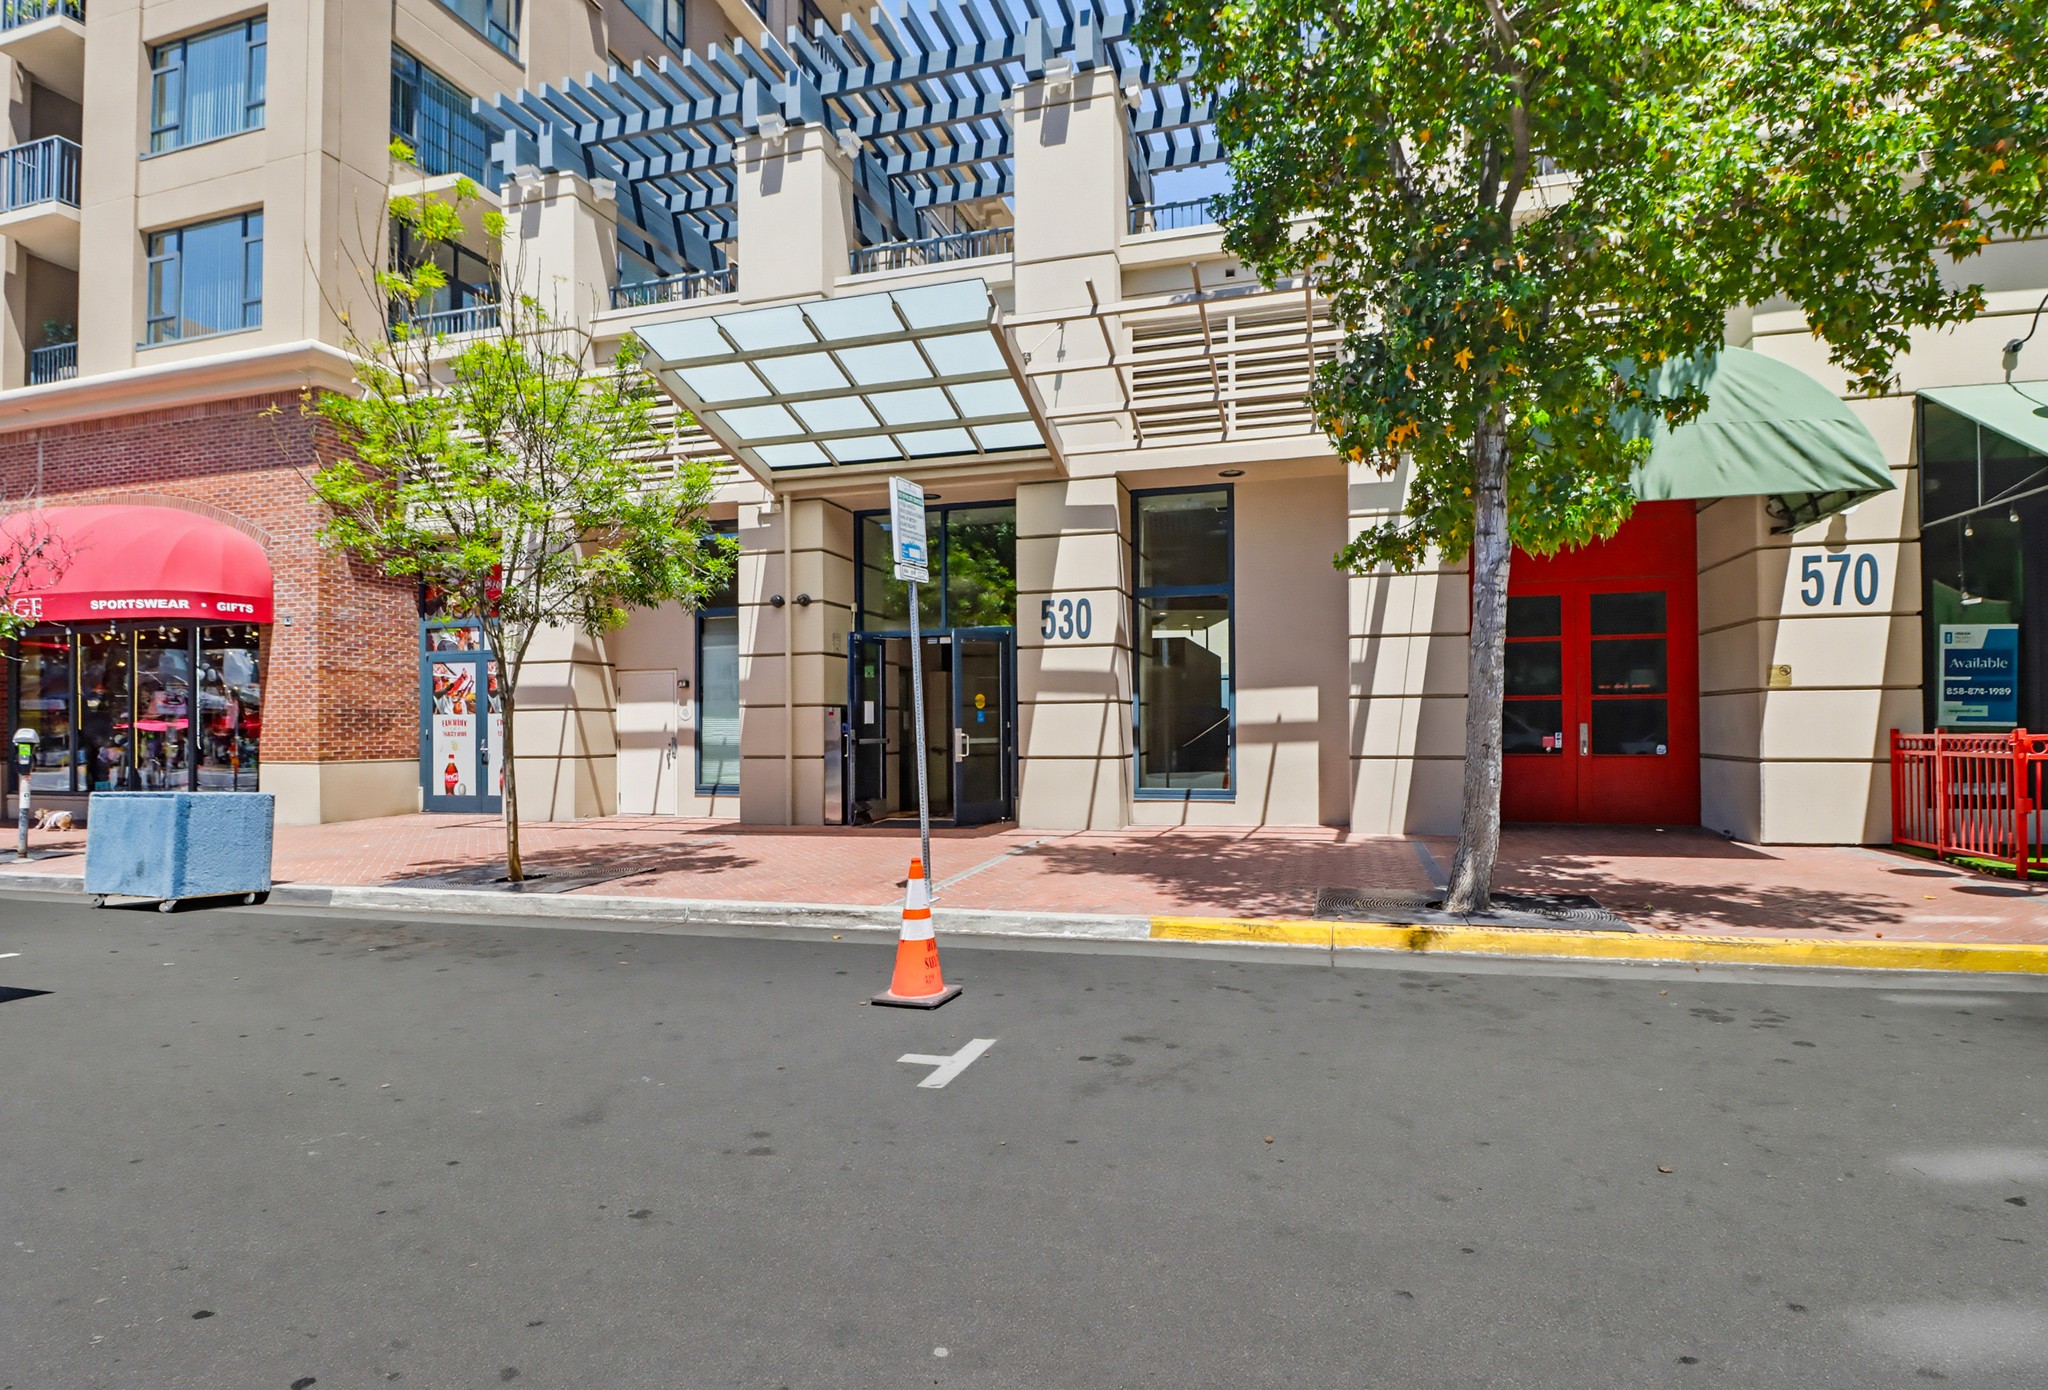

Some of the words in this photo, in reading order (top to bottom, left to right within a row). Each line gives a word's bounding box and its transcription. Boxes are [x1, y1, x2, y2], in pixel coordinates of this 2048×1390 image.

[1801, 553, 1879, 607] 570
[2, 597, 43, 618] GE
[90, 599, 190, 610] SPORTSWEAR
[216, 602, 254, 613] GIFTS
[1041, 598, 1092, 640] 530
[1949, 657, 2009, 669] Available
